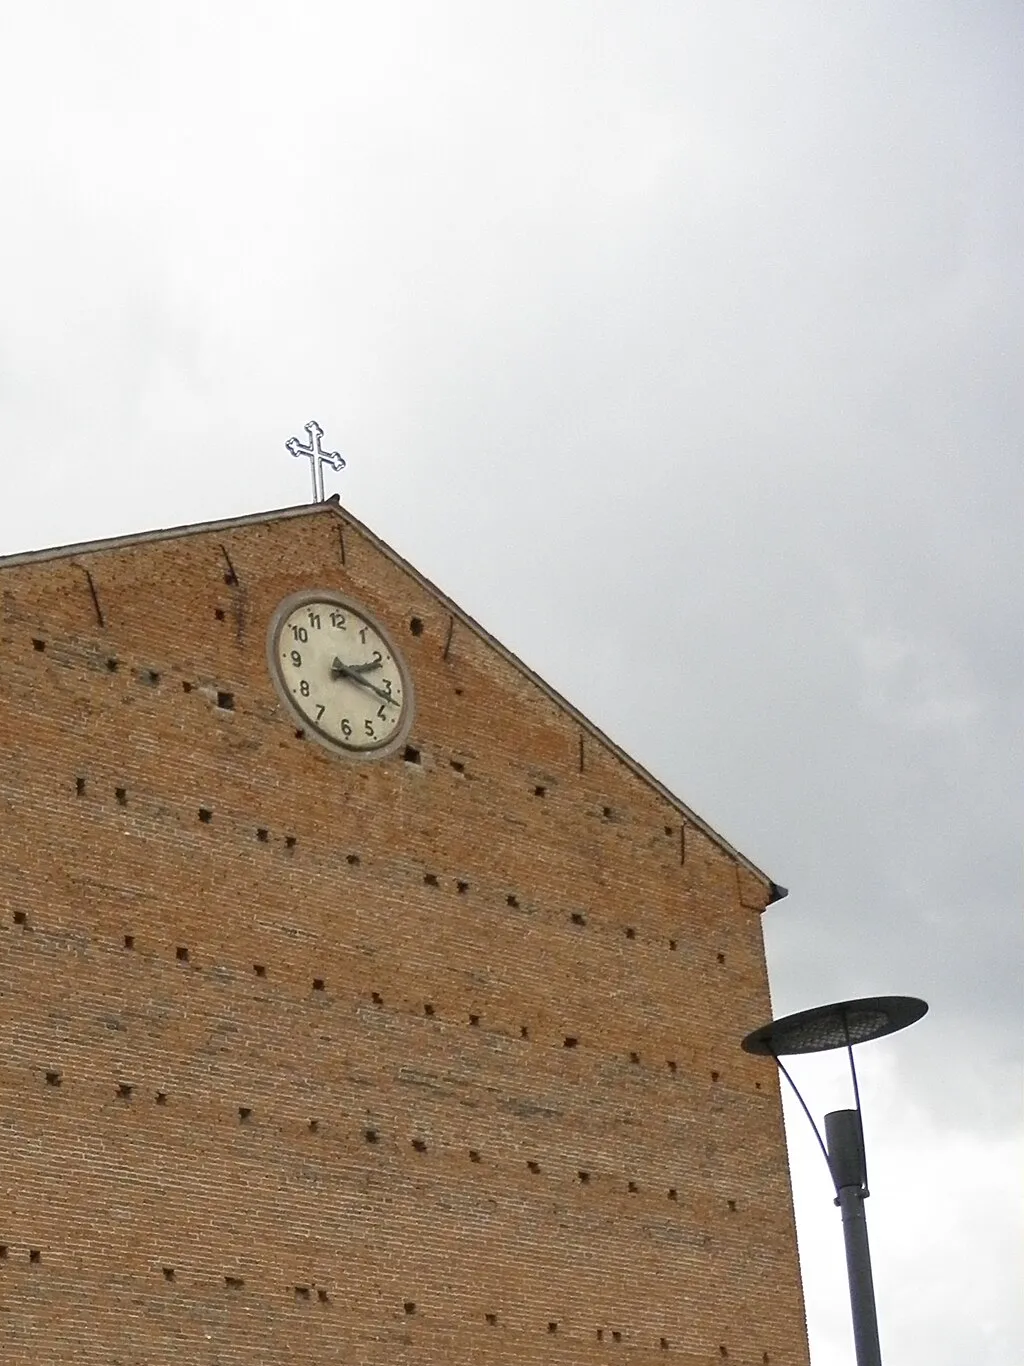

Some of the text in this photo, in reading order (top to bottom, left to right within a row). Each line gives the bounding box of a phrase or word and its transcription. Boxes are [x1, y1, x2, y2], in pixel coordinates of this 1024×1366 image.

[308, 612, 321, 629] 11
[329, 613, 347, 630] 12
[291, 625, 308, 643] 10
[359, 628, 366, 644] 1
[291, 650, 302, 668] 9
[372, 651, 383, 668] 2
[299, 680, 310, 697] 8
[382, 678, 392, 696] 3
[315, 704, 326, 720] 7
[377, 705, 387, 721] 4
[340, 719, 352, 736] 6
[364, 720, 374, 736] 5
